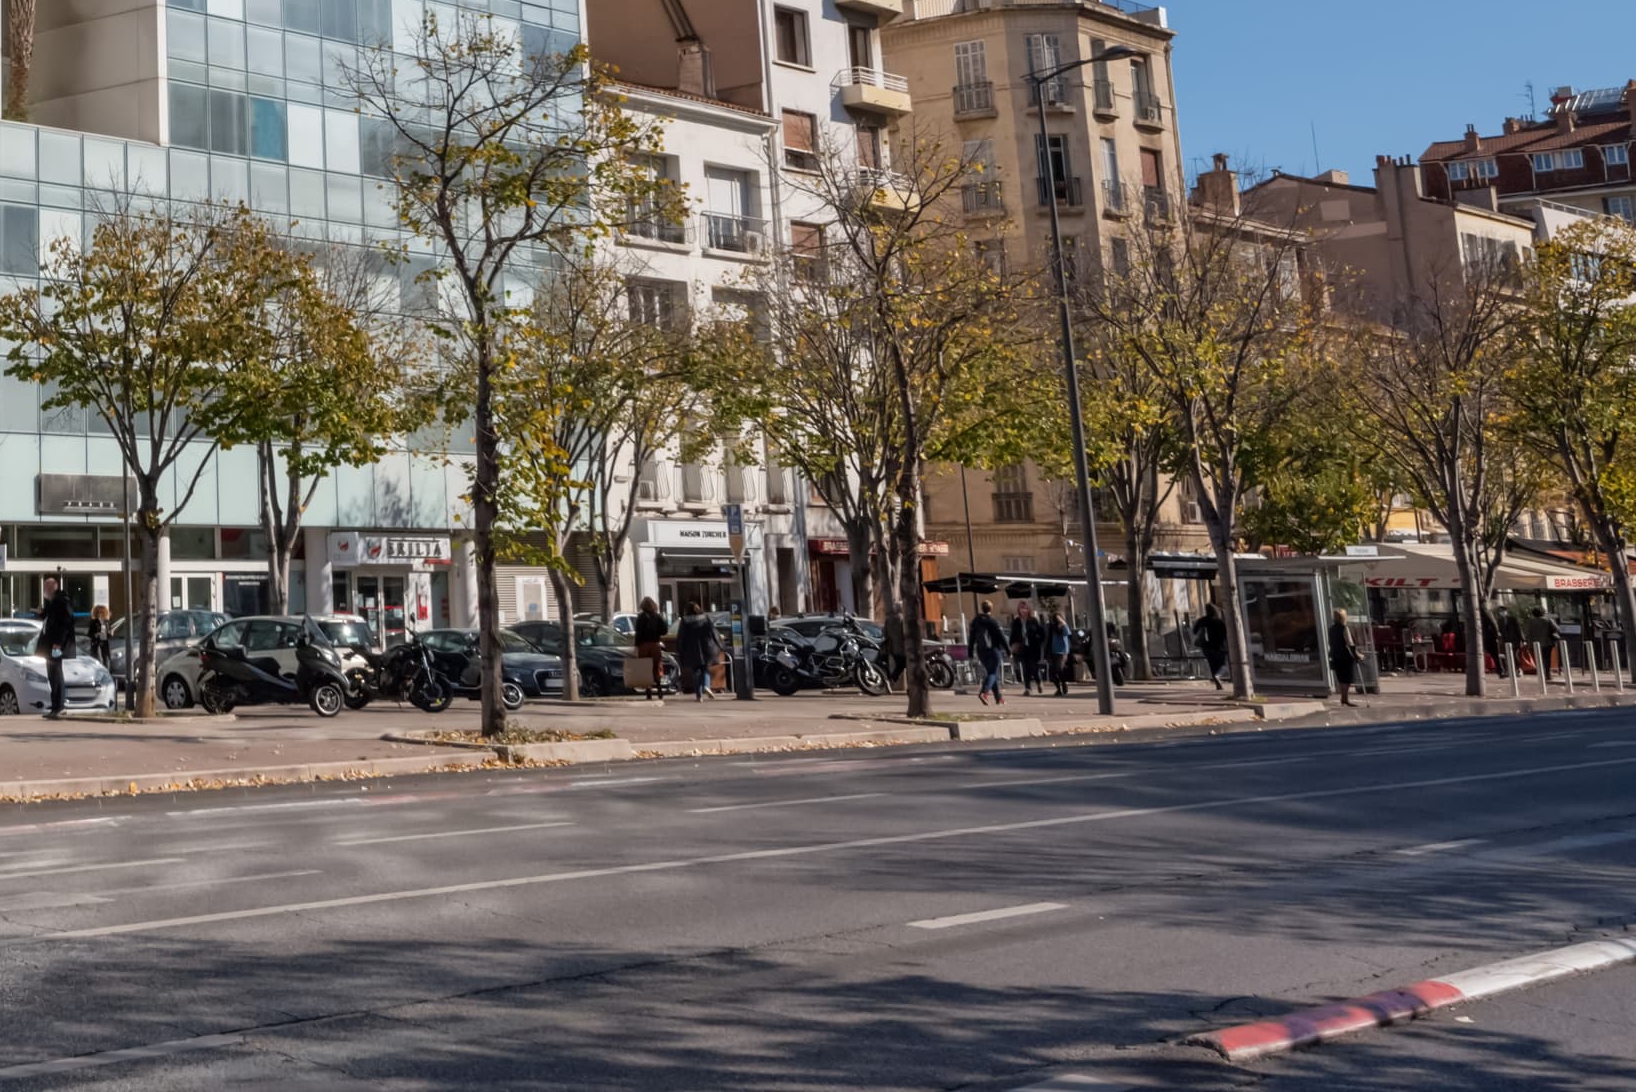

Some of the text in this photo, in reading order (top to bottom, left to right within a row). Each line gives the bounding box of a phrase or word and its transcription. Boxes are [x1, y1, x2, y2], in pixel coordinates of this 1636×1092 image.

[679, 530, 700, 538] MAISON
[1359, 577, 1438, 587] KILT
[1554, 579, 1601, 588] BRASSERIE
